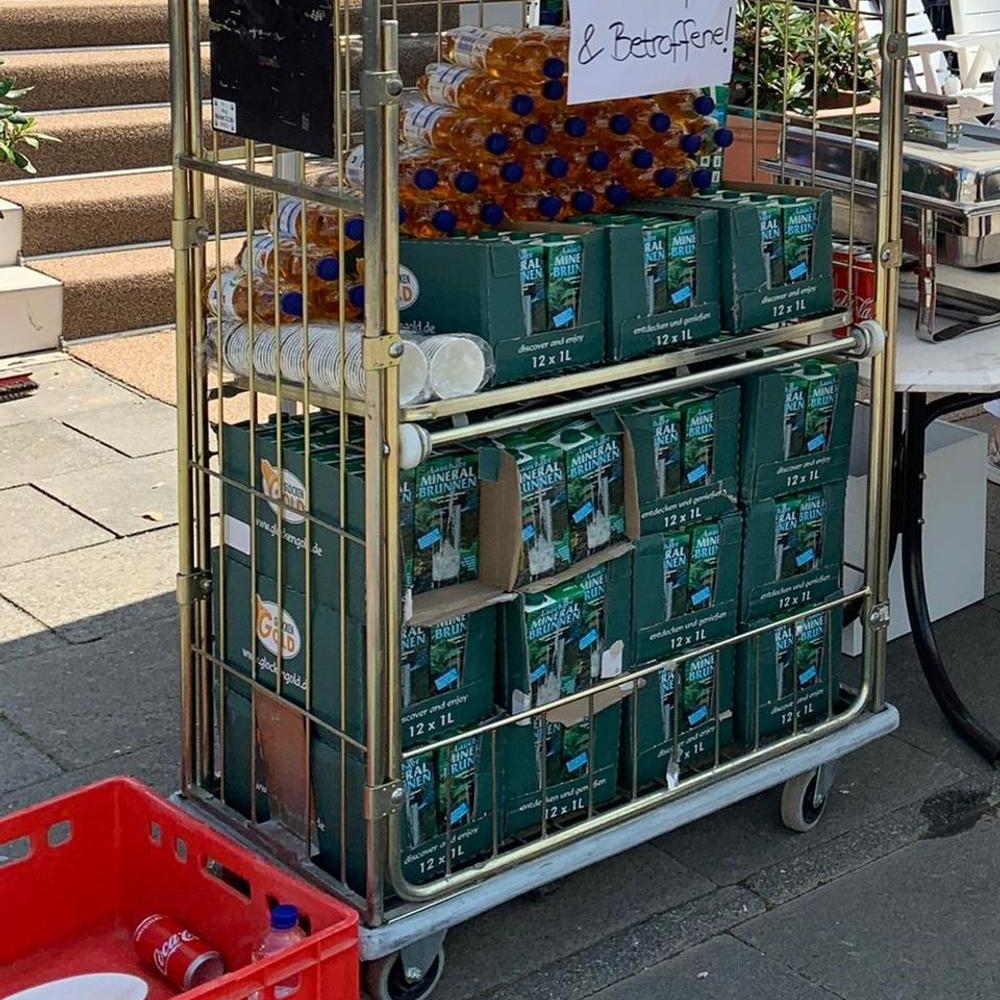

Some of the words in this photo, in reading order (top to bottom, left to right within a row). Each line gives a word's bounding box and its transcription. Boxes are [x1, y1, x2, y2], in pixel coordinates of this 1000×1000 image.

[577, 23, 605, 65] &
[608, 6, 733, 64] Betroffene!
[772, 305, 784, 317] 12
[786, 305, 792, 314] x
[796, 300, 806, 311] 1L
[518, 339, 550, 354] discover
[550, 337, 565, 348] and
[565, 334, 584, 348] enjoy
[656, 334, 668, 346] 12
[671, 335, 678, 343] x
[682, 330, 692, 342] 1L
[532, 354, 546, 368] 12
[548, 355, 556, 364] x
[560, 350, 572, 363] 1L
[570, 448, 620, 478] BRUNNEN
[572, 440, 618, 468] MINERAL
[420, 466, 476, 488] MINERAL
[520, 462, 560, 484] INERAL
[522, 470, 562, 494] UNNEN
[787, 475, 798, 487] 12
[800, 475, 806, 483] x
[810, 470, 820, 480] 1L
[418, 476, 476, 498] BRUNNEN
[641, 504, 678, 519] entdecken
[678, 497, 693, 508] und
[664, 514, 678, 528] 12
[680, 514, 687, 523] x
[690, 507, 702, 519] 1L
[778, 597, 792, 608] 12
[802, 590, 811, 602] 1L
[528, 612, 580, 640] BRUNNEN
[530, 603, 580, 628] MINERAL
[435, 622, 468, 640] BRUN
[670, 638, 682, 649] 12
[695, 632, 706, 643] 1L
[401, 707, 428, 723] scover
[429, 700, 446, 714] and
[446, 694, 469, 708] enjoy
[782, 711, 793, 725] 12
[804, 703, 814, 714] 1L
[408, 722, 425, 738] 12
[428, 721, 436, 732] x
[440, 712, 454, 726] 1L
[694, 742, 705, 754] 1L
[520, 796, 559, 812] entdeken
[544, 806, 558, 820] 12
[560, 805, 568, 815] x
[572, 798, 584, 810] 1L
[404, 844, 438, 864] discover
[439, 834, 457, 849] ad
[457, 826, 480, 840] enjoy
[420, 858, 434, 874] 12
[438, 855, 446, 865] x
[451, 845, 464, 859] 1L
